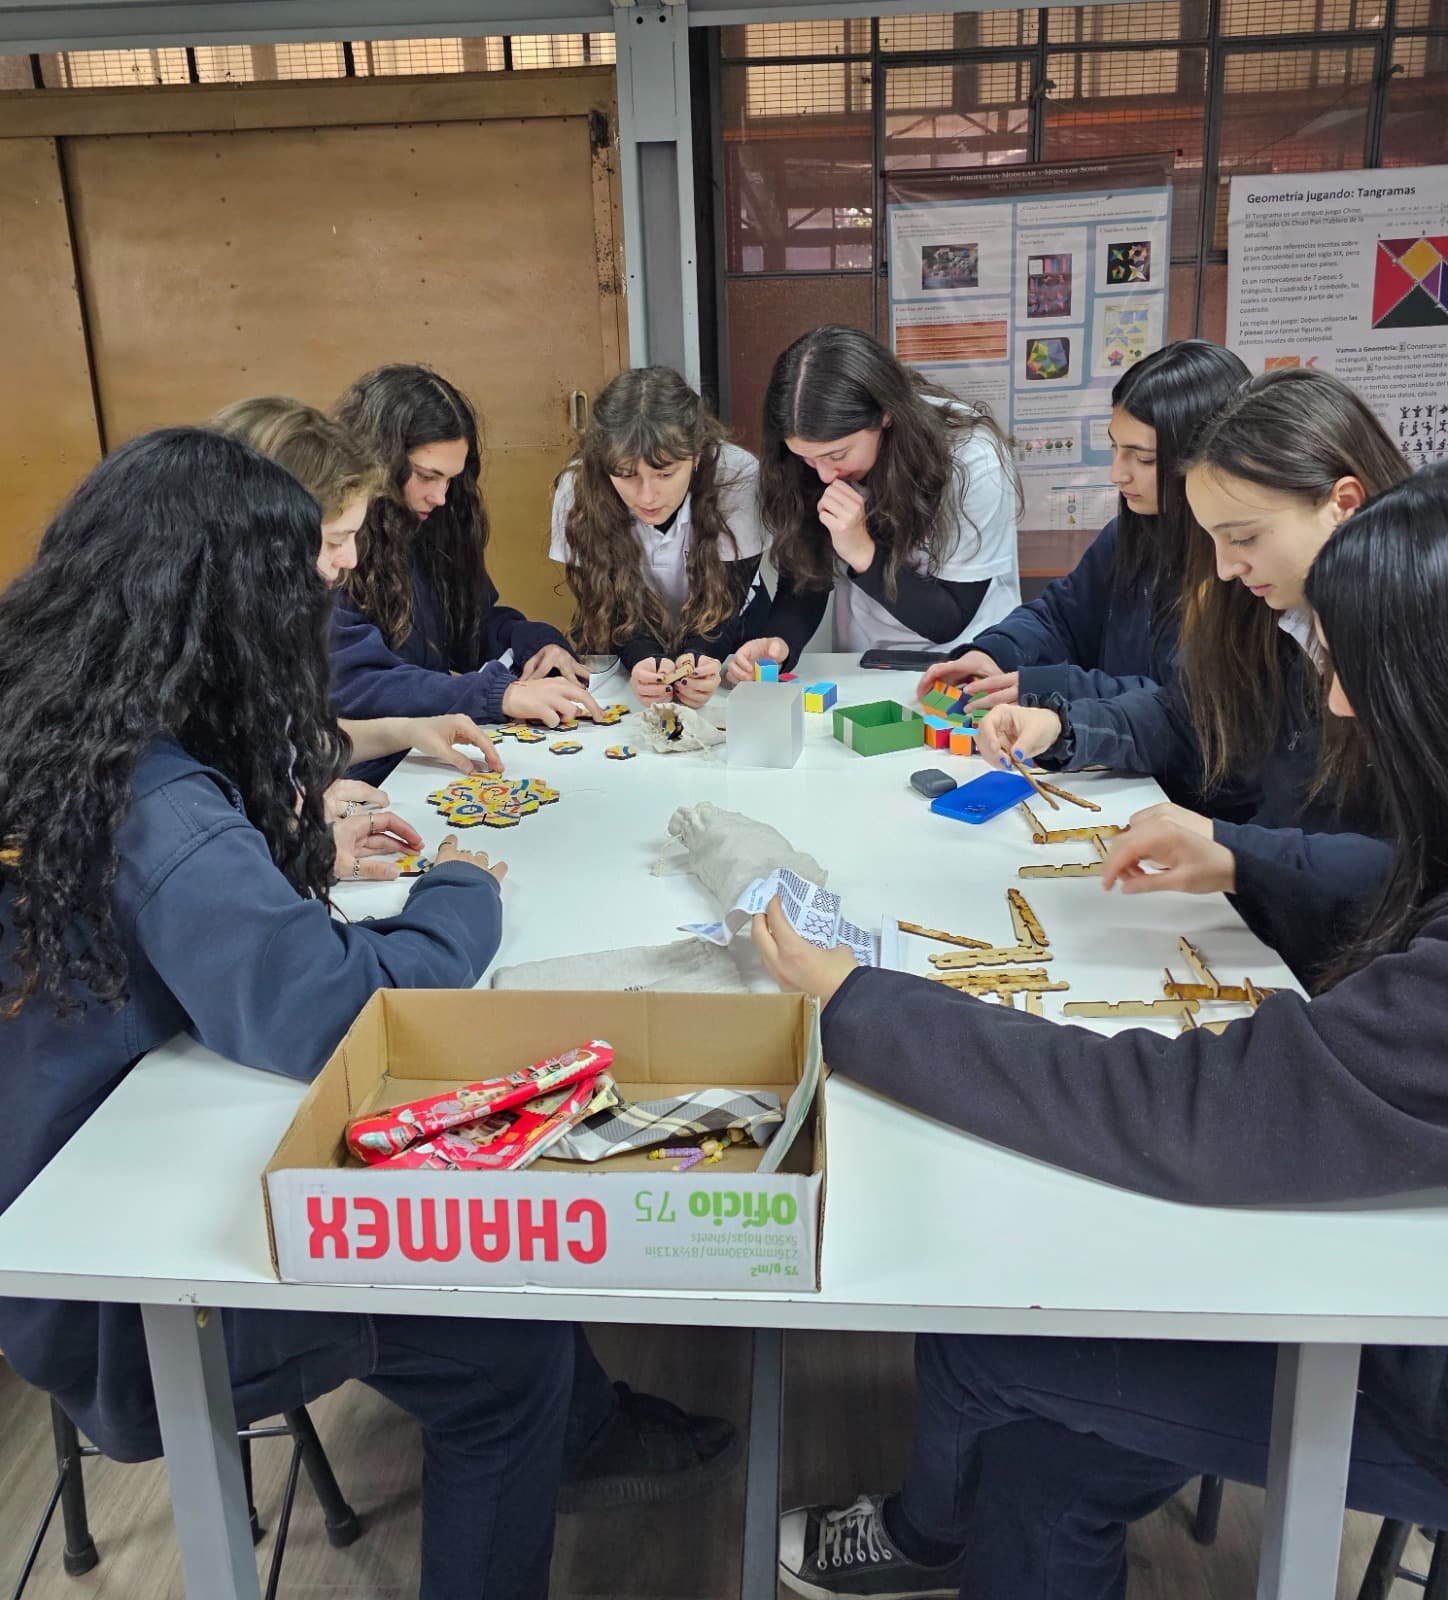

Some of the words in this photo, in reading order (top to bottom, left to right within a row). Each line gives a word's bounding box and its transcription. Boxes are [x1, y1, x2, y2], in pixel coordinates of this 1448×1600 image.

[1247, 190, 1304, 204] Geometría
[1306, 188, 1354, 203] jugando:
[1358, 186, 1416, 199] Tangramas
[634, 1190, 677, 1223] 75
[306, 1196, 607, 1264] CHAMEX
[690, 1231, 762, 1245] hojas/sheets
[765, 1233, 798, 1245] 5x500
[784, 1265, 799, 1276] 75
